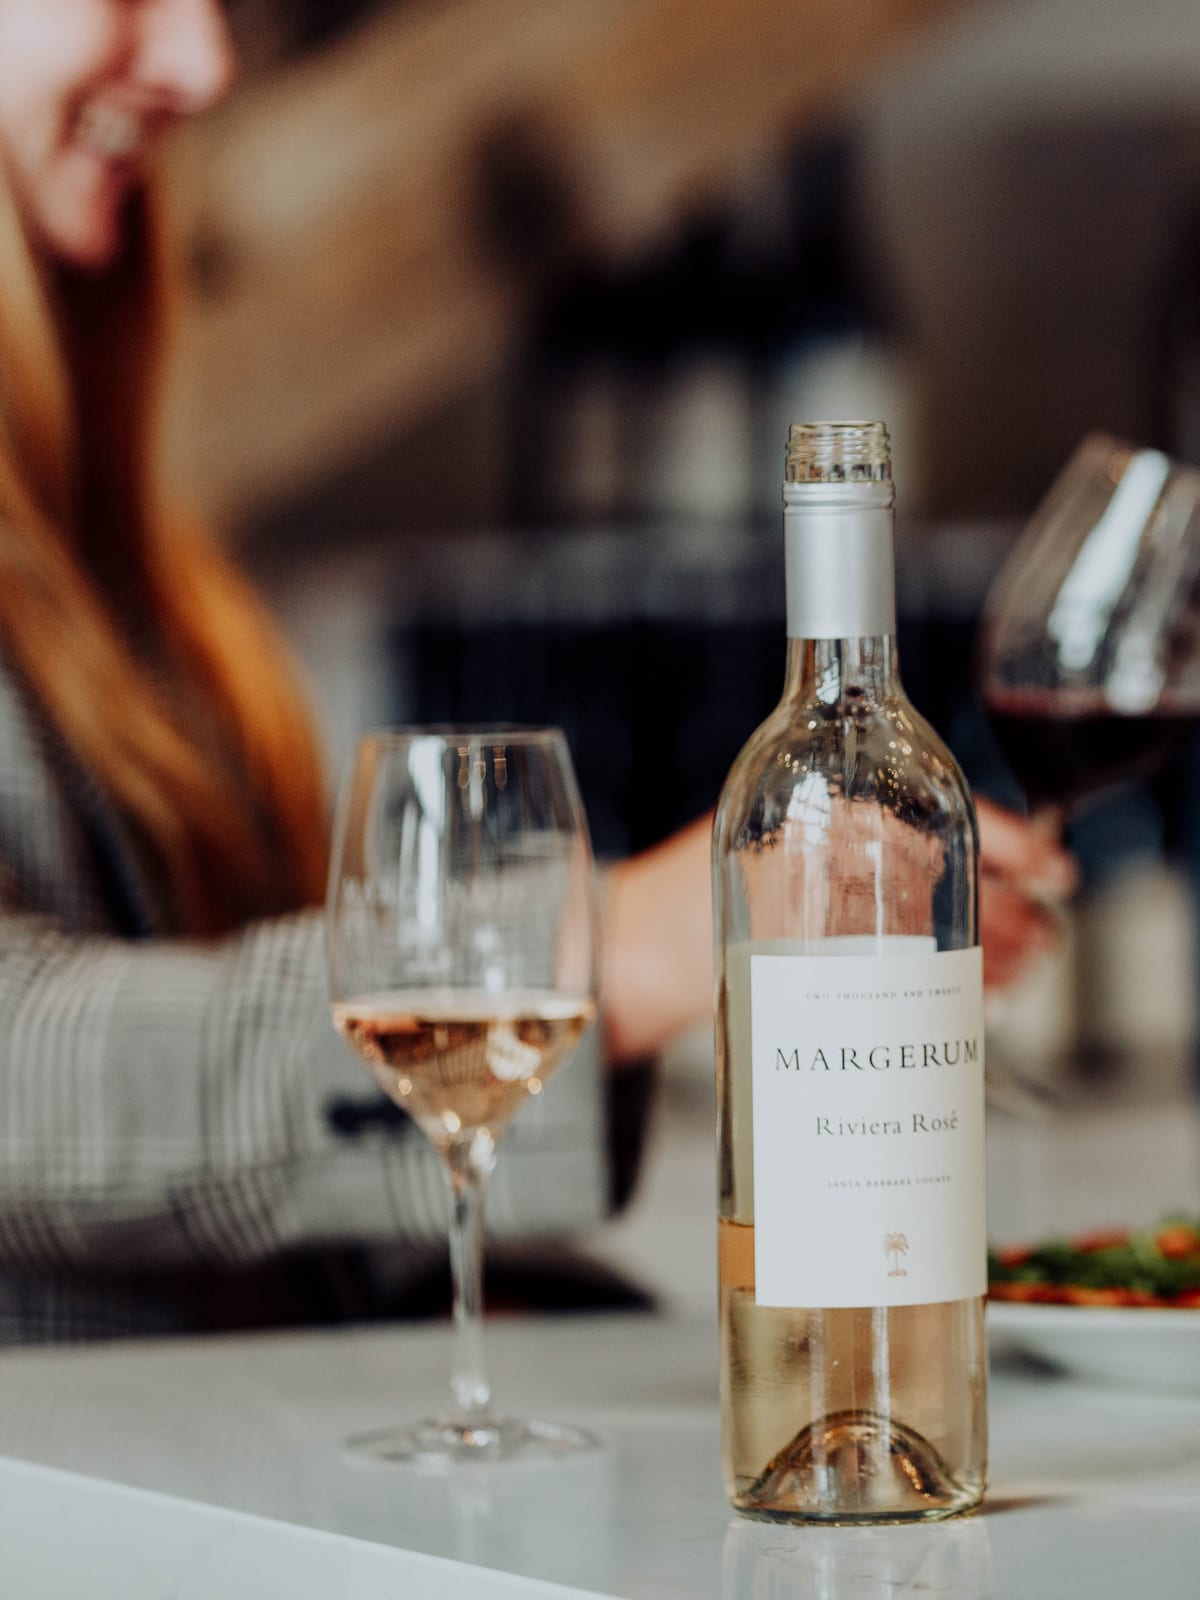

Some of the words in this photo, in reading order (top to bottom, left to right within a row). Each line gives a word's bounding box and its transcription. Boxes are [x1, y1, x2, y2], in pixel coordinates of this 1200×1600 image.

[775, 1037, 979, 1071] MARGERUM
[815, 1115, 902, 1136] Riviera
[911, 1109, 959, 1133] Rosé
